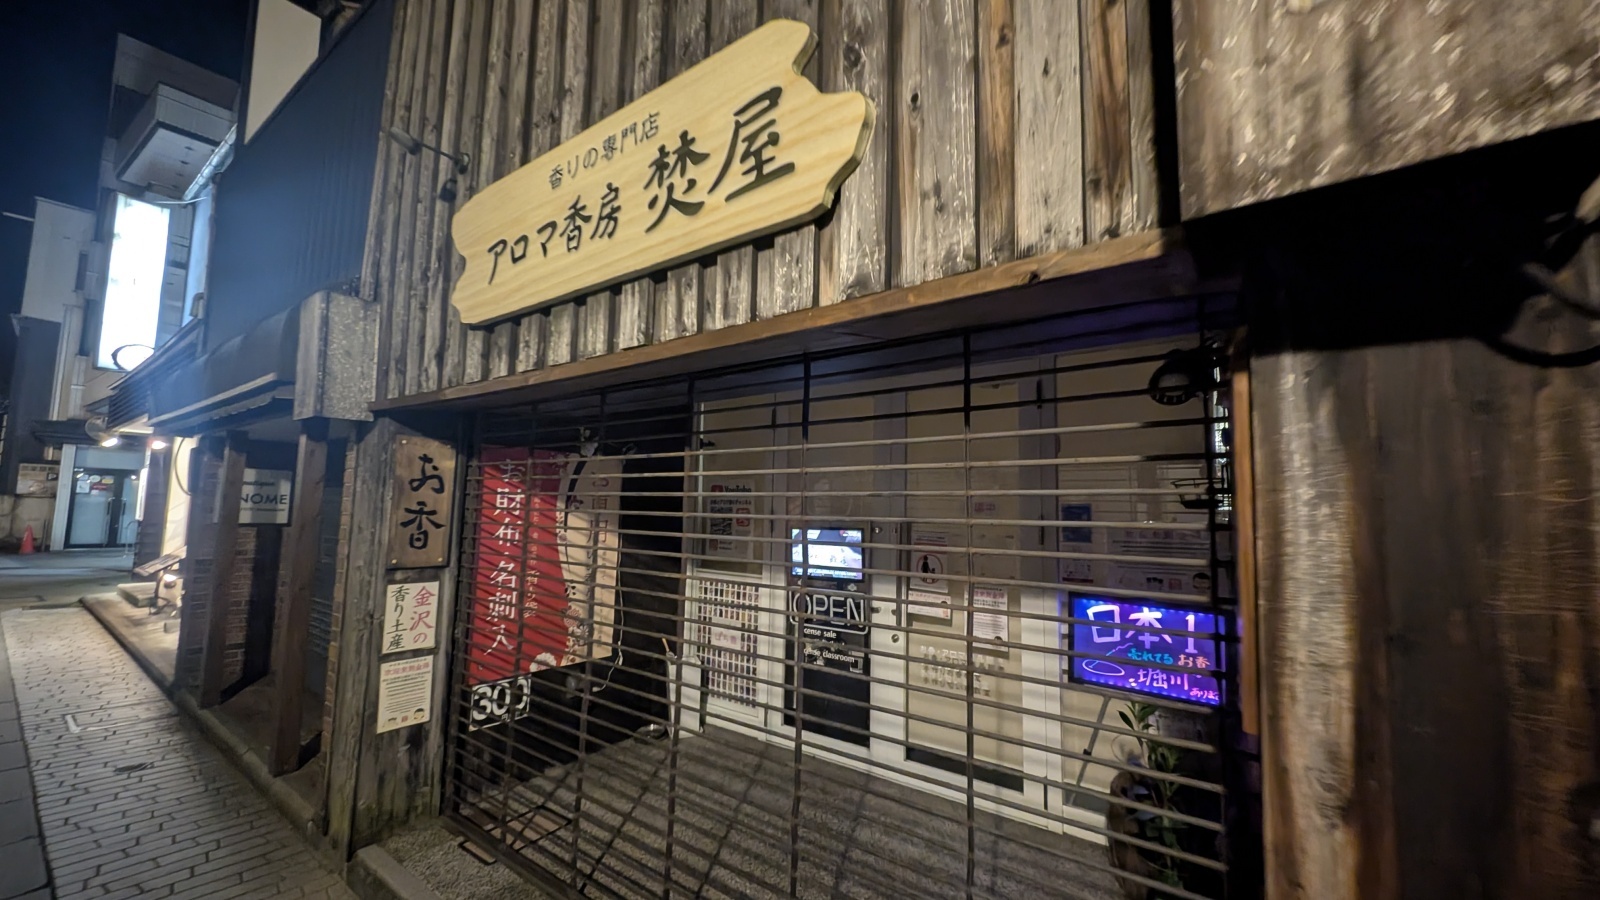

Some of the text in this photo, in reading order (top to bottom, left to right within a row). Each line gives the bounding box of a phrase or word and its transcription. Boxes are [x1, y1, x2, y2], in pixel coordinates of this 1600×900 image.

[548, 111, 661, 190] 香りの専門店
[487, 86, 795, 285] アロマ香房 焚屋
[400, 453, 446, 550] お香
[386, 585, 410, 651] 香り土産
[409, 586, 436, 643] 金沢の
[793, 591, 865, 628] OPEN
[1178, 654, 1211, 669] お香
